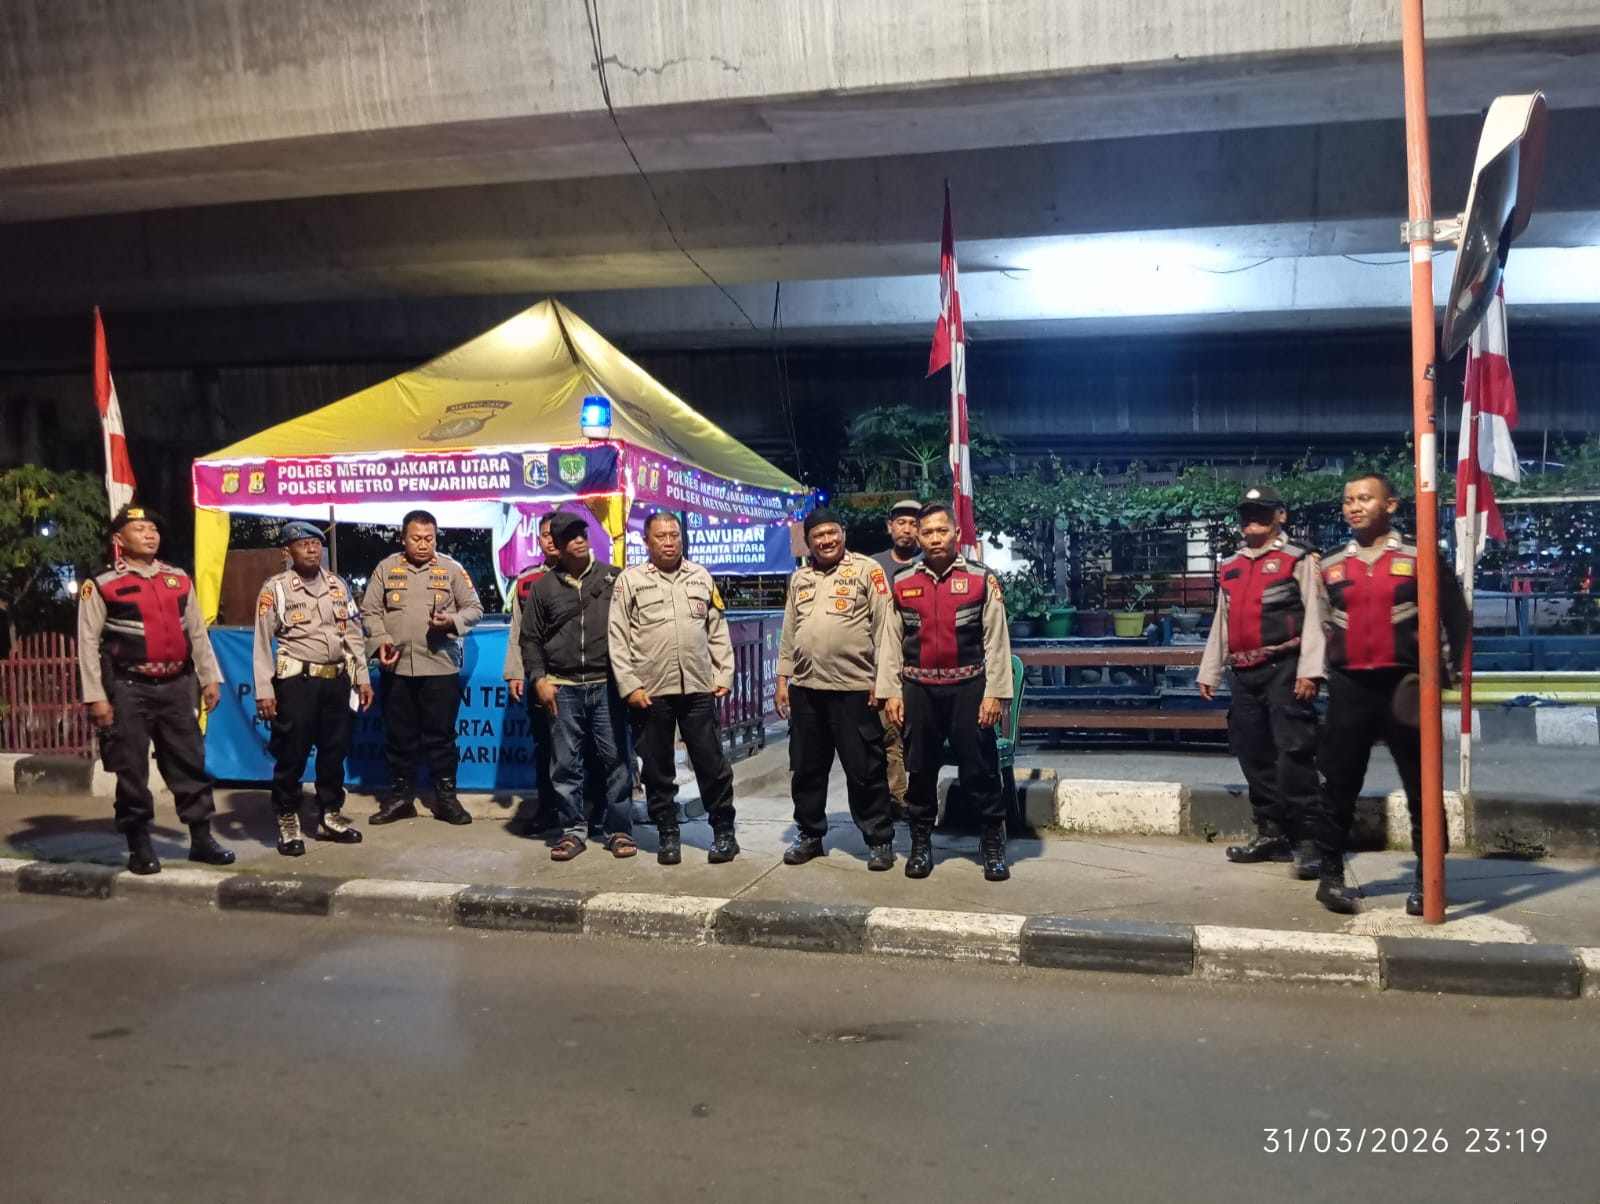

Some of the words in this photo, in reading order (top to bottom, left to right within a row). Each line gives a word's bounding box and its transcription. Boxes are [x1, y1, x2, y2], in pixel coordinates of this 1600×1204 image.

[278, 465, 332, 479] POLRES
[337, 463, 387, 477] METRO
[391, 459, 456, 476] JAKARTA
[461, 458, 510, 474] UTARA
[278, 478, 336, 495] POLSEK
[341, 477, 393, 493] METRO
[398, 475, 510, 492] PENJARINGAN
[667, 469, 699, 491] POLRES
[700, 482, 726, 500] METRO
[725, 490, 761, 505] JAKARTA
[761, 496, 783, 509] UTARA
[666, 485, 701, 506] POLSEK
[702, 496, 732, 513] METRO
[732, 503, 788, 519] PENJARINGAN
[687, 527, 765, 544] TAWURAN
[688, 544, 730, 554] JAKARTA
[732, 543, 766, 553] UTARA
[692, 554, 766, 564] PENJARINGAN
